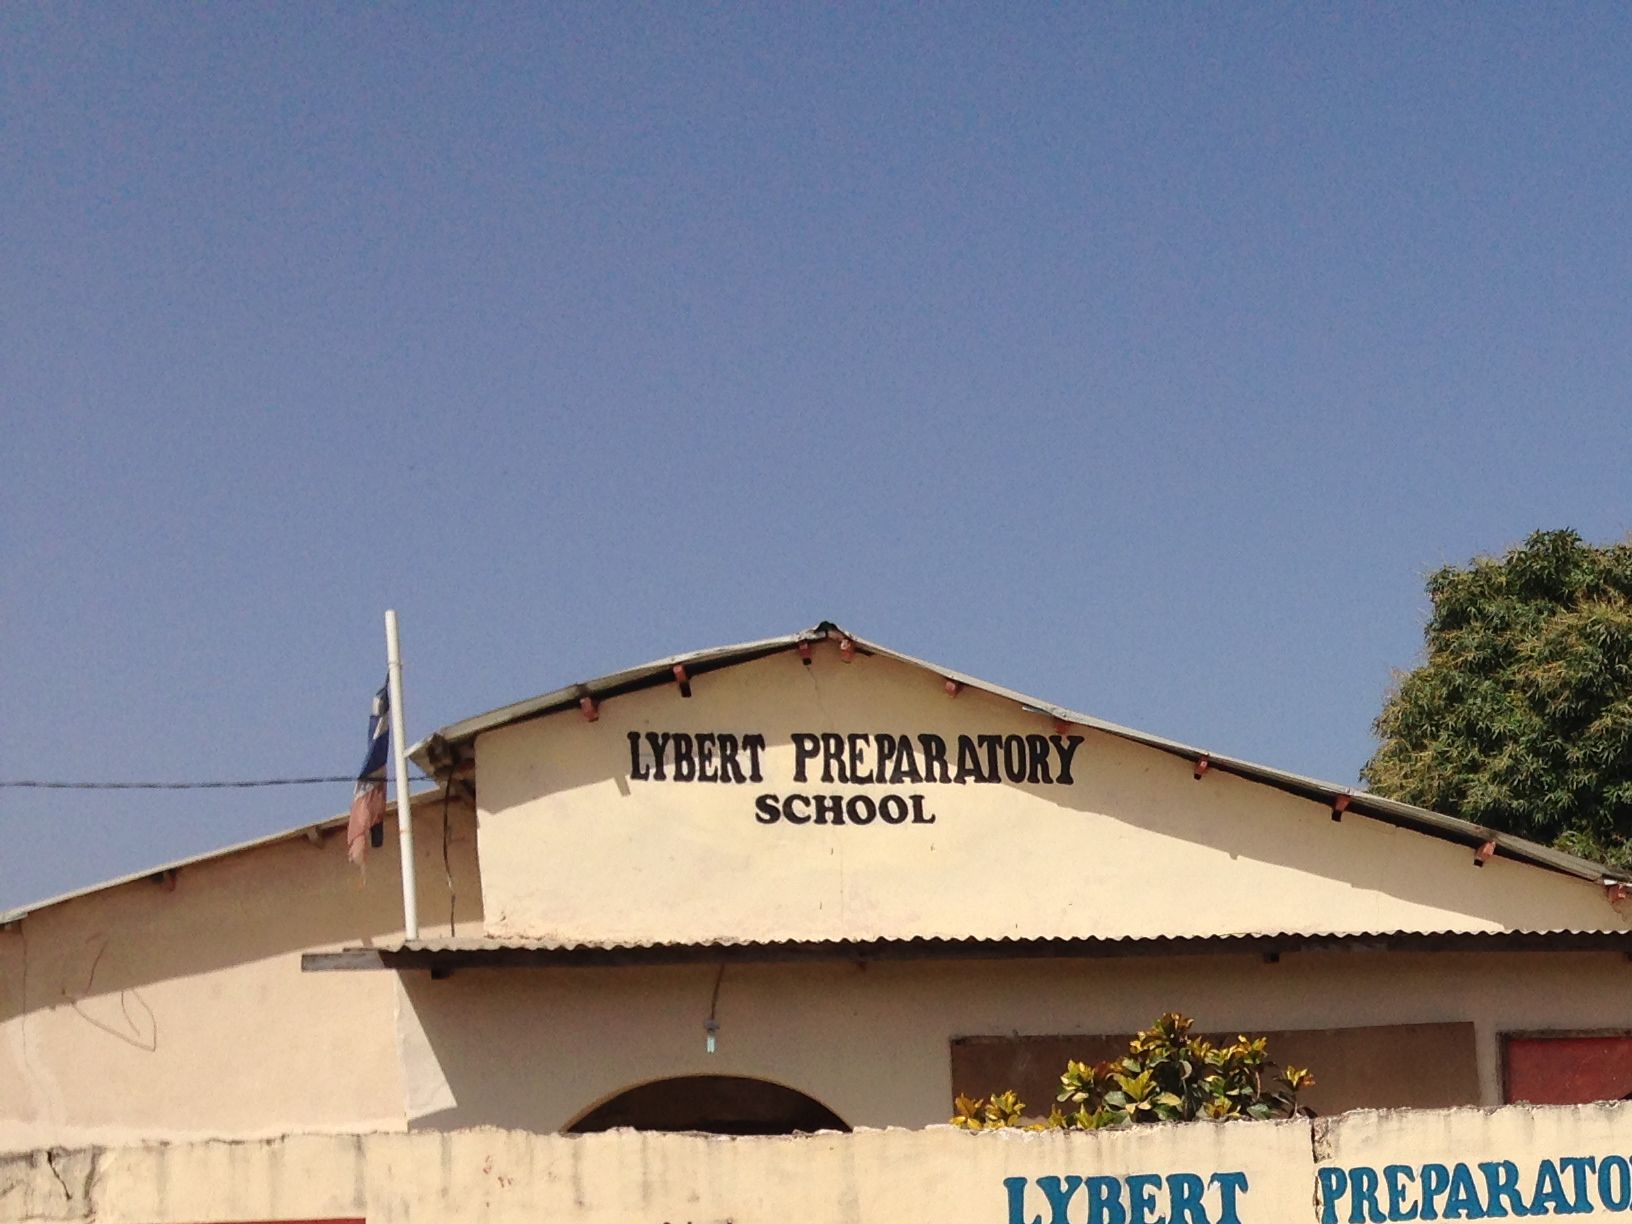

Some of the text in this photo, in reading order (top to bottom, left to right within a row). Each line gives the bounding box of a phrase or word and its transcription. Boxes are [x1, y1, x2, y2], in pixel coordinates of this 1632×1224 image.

[627, 732, 1085, 785] LYBERT PREPARATORY
[755, 794, 936, 825] SCHOOL
